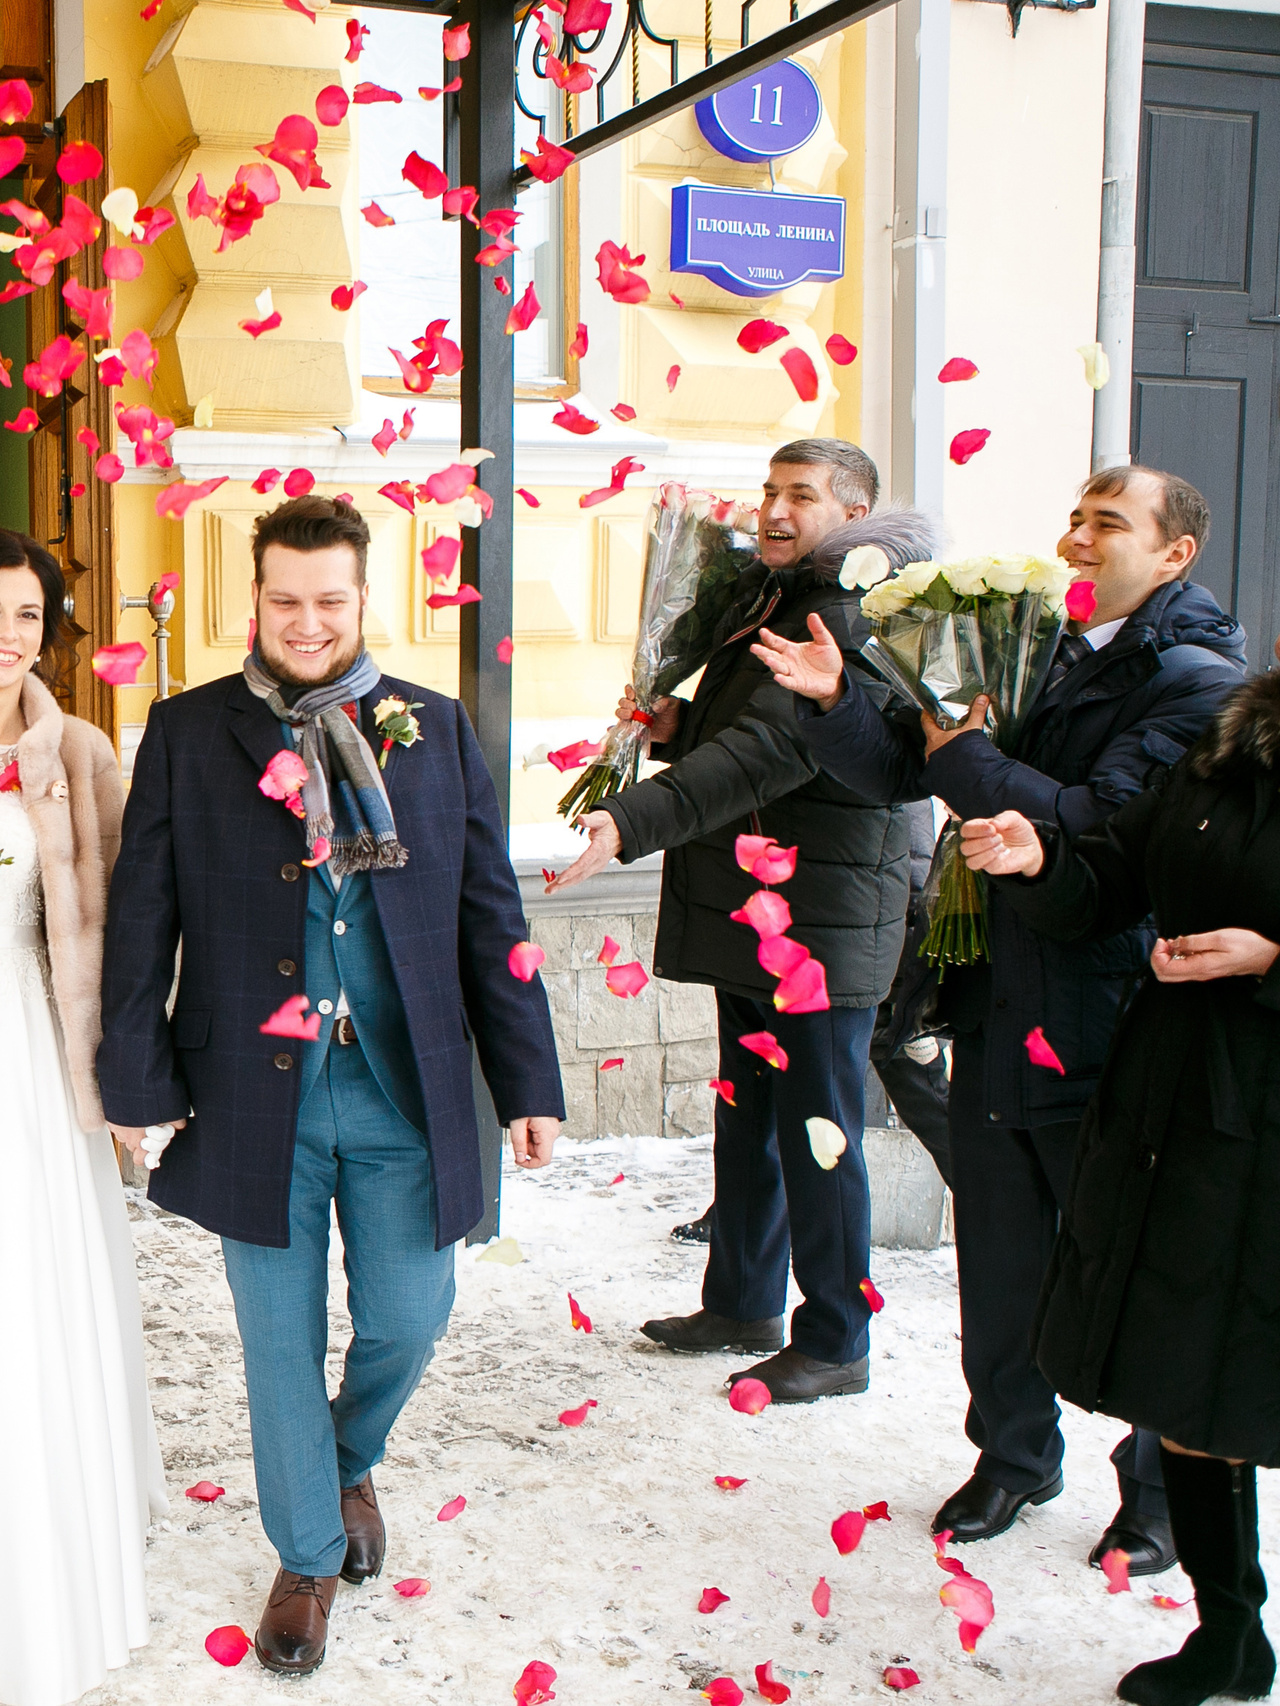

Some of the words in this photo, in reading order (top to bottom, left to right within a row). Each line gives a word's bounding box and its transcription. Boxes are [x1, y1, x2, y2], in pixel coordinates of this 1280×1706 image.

[749, 83, 784, 126] 11
[696, 217, 771, 238] ПЛОЩАДЬ
[775, 224, 835, 242] ЛЕНИНА
[747, 266, 785, 281] УЛИЦА
